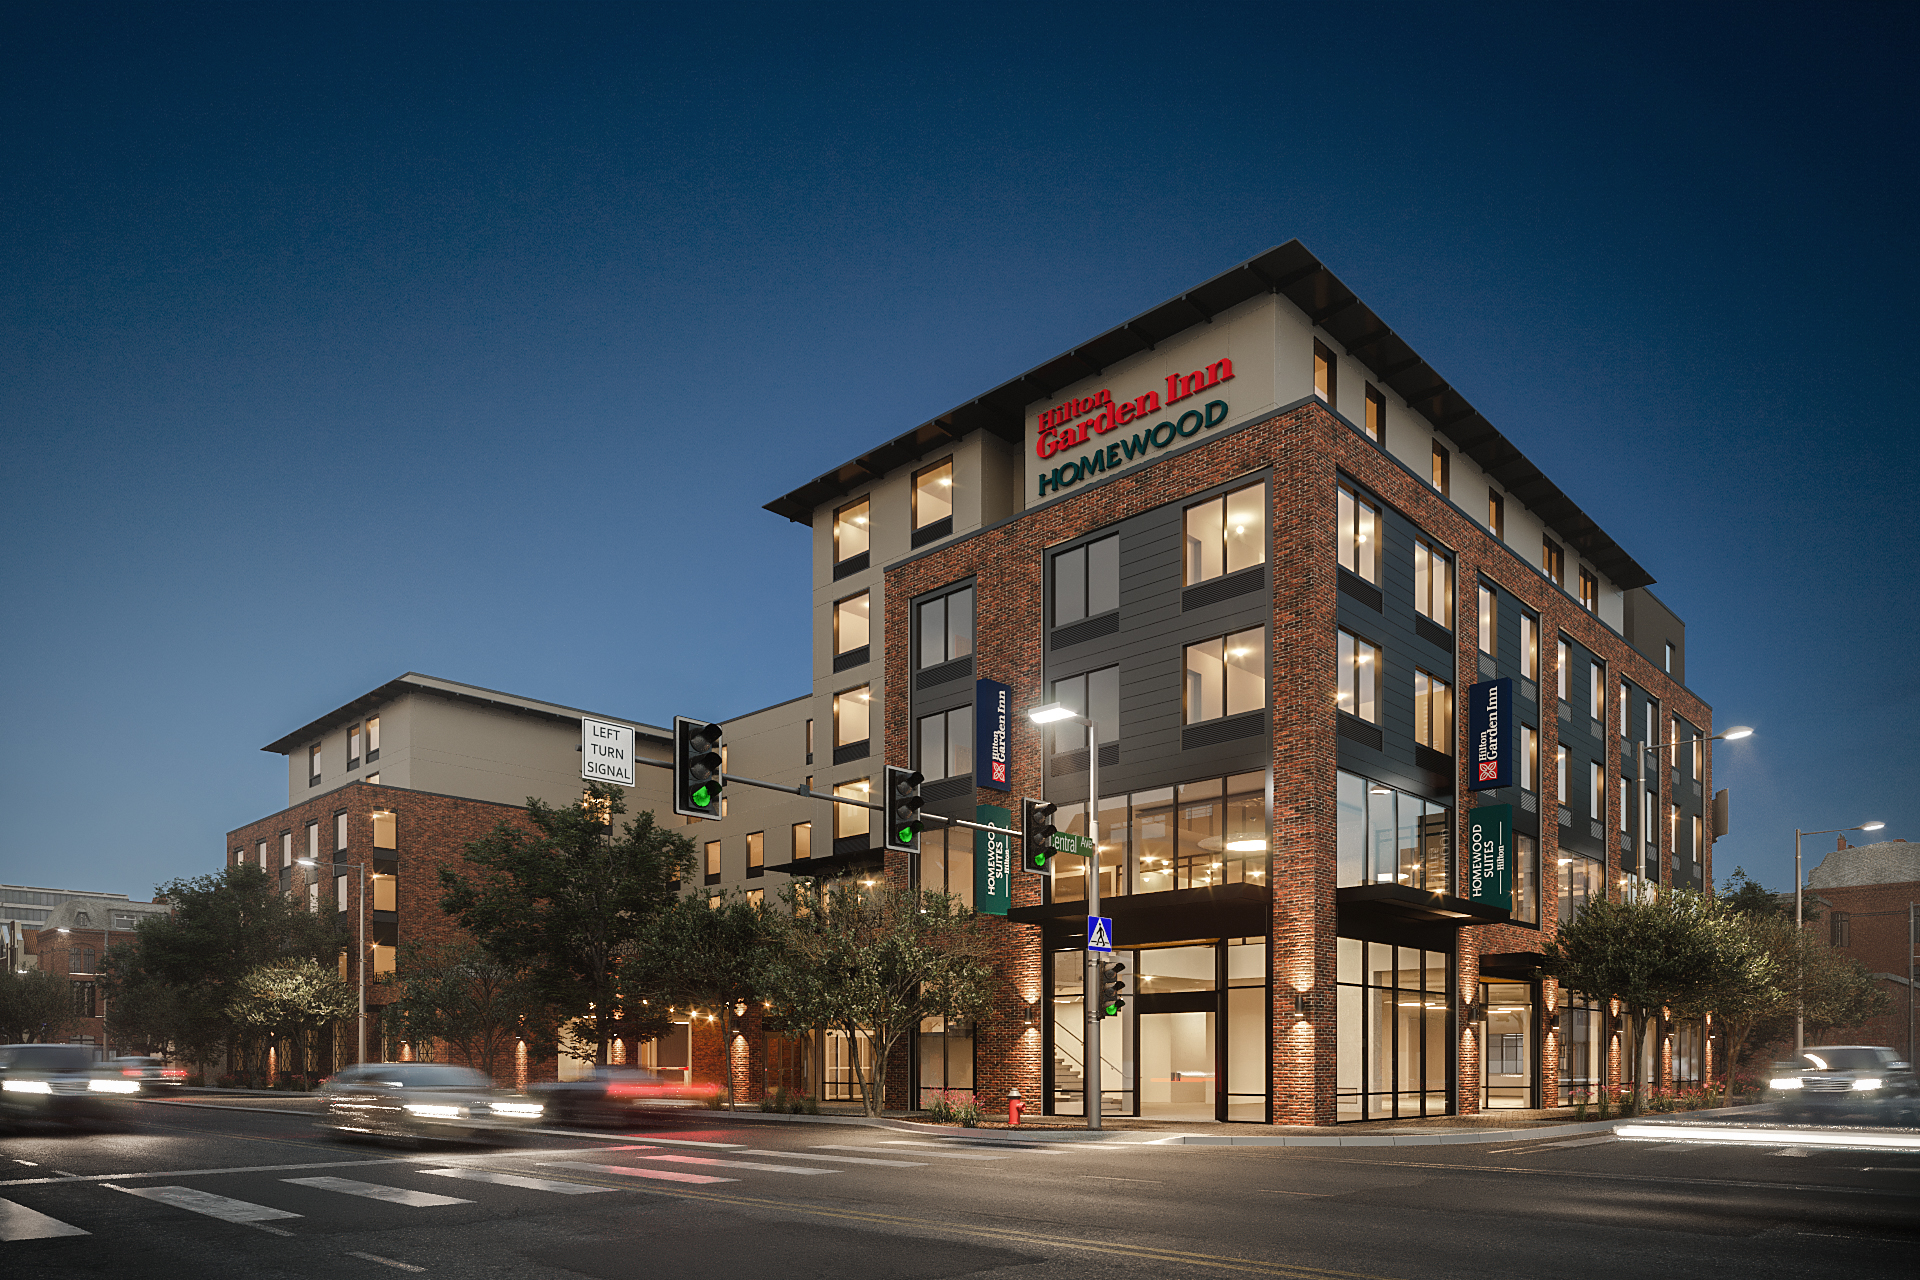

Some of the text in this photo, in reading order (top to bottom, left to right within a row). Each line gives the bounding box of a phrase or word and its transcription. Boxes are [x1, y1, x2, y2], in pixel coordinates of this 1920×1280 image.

[1036, 357, 1235, 459] Garden Inn
[1037, 388, 1113, 434] Hilton
[1038, 399, 1229, 496] HOMEWOOD
[593, 725, 620, 740] LEFT
[997, 690, 1006, 762] Garden Inn
[1486, 685, 1498, 760] Garden Inn
[591, 743, 624, 760] TURN
[1479, 731, 1487, 762] Hilton
[587, 761, 631, 780] SIGNAL
[995, 841, 1003, 878] SUITES
[1051, 834, 1093, 853] entral Ave
[1472, 824, 1482, 898] HOMEWOOD
[1483, 840, 1494, 878] SUITES
[1496, 844, 1505, 871] Hilton
